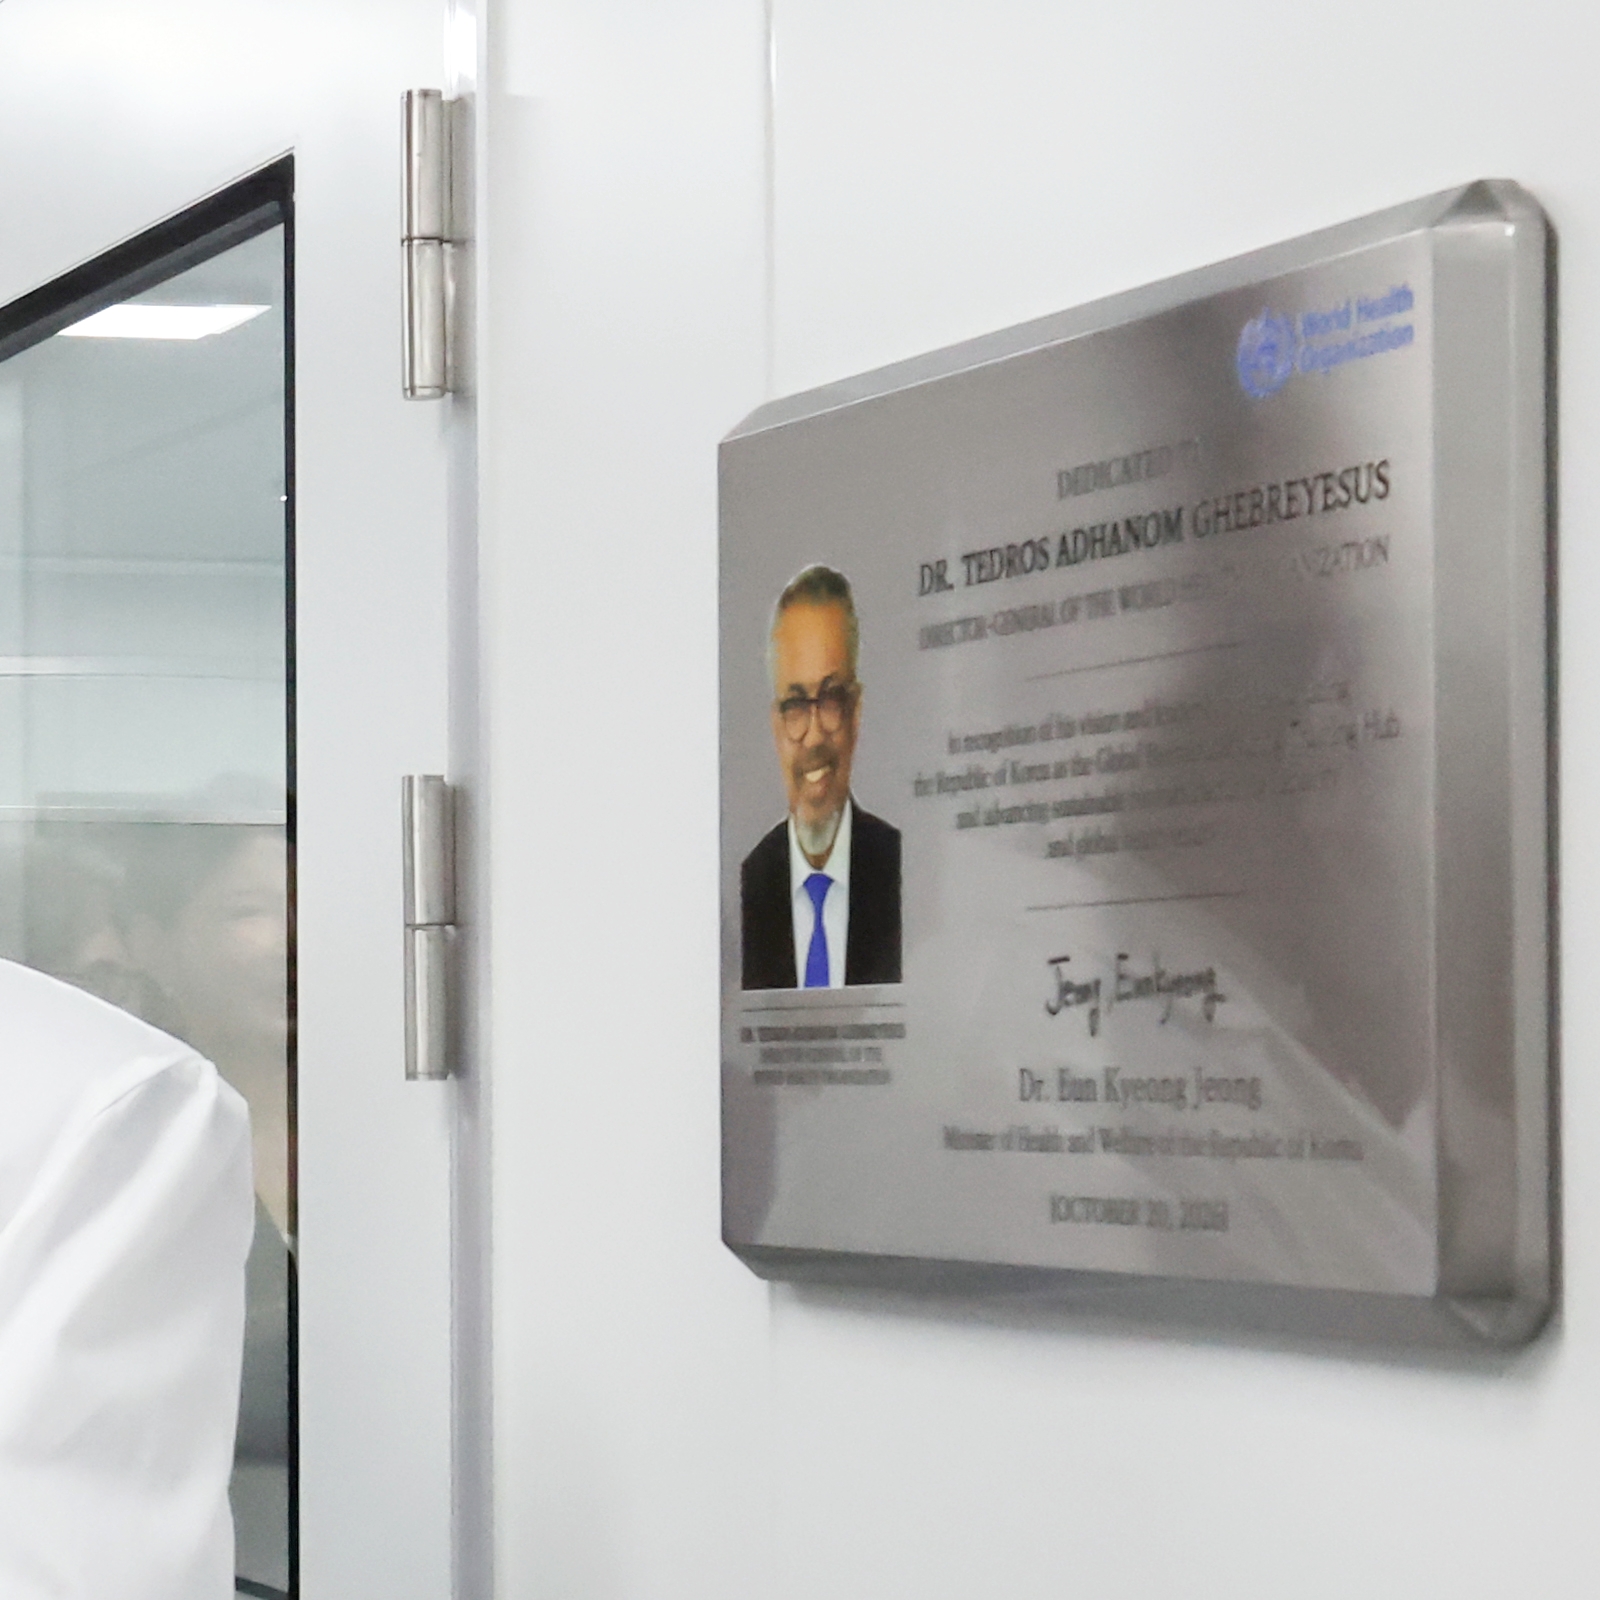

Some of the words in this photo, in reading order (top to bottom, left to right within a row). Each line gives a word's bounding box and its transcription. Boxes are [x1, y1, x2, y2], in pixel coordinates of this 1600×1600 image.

[1057, 445, 1172, 499] DEDICATED
[918, 558, 954, 597] DR.
[961, 536, 1050, 588] TEDROS
[1056, 506, 1183, 568] ADHANOM
[1193, 459, 1390, 538] GHEBREYESUS
